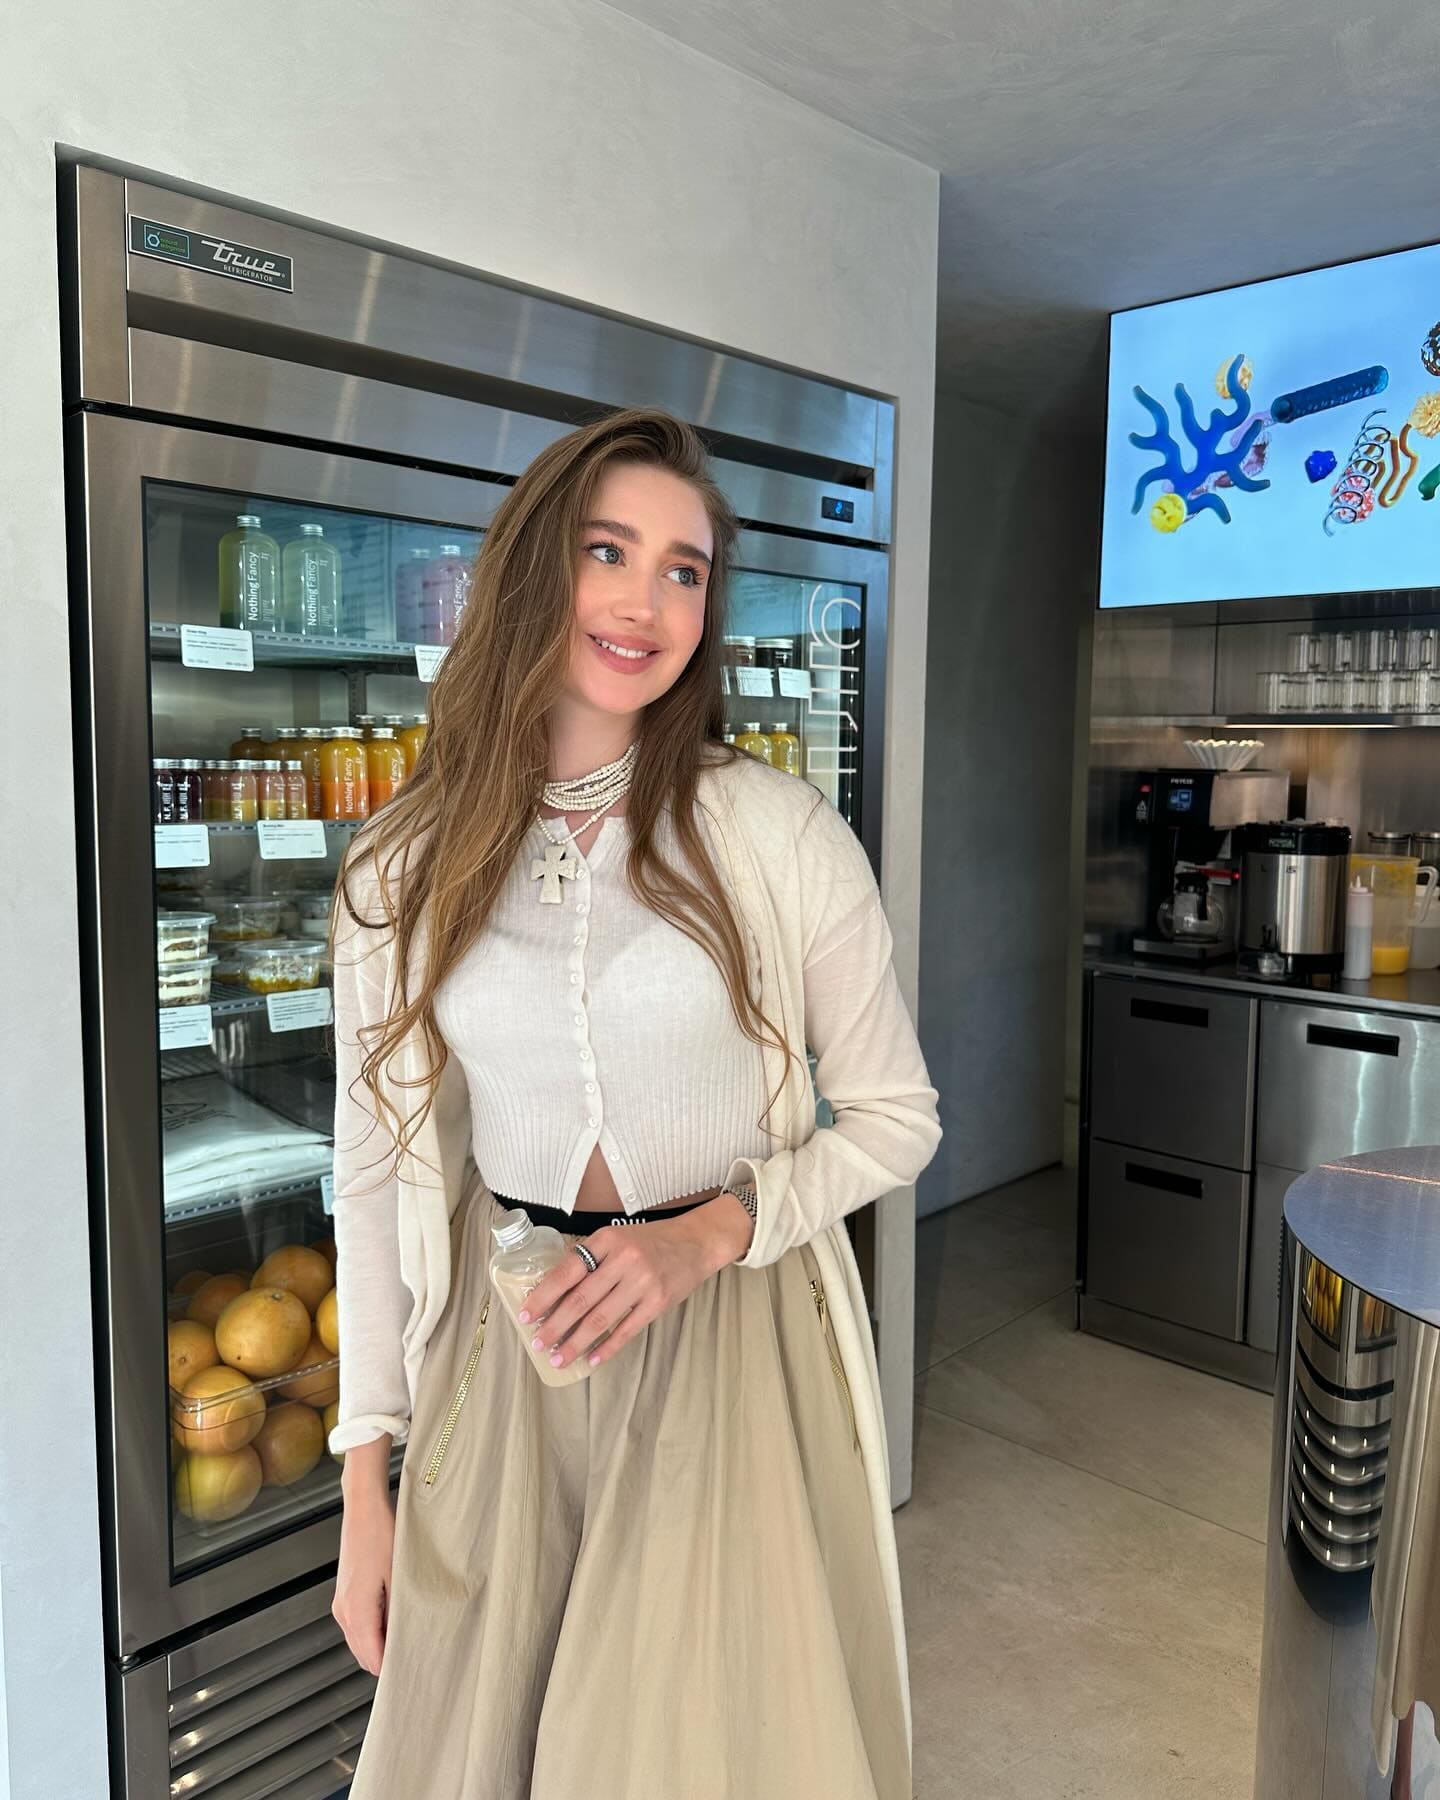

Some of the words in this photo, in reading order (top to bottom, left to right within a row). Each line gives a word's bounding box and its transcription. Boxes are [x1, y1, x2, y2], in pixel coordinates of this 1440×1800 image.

[223, 264, 274, 283] REFRIGERATOR
[247, 552, 260, 581] Fancy
[307, 559, 319, 588] Fancy
[247, 582, 260, 621] Nothing
[307, 589, 319, 626] Nothing
[344, 758, 353, 781] Fancy
[344, 782, 354, 813] Nothing
